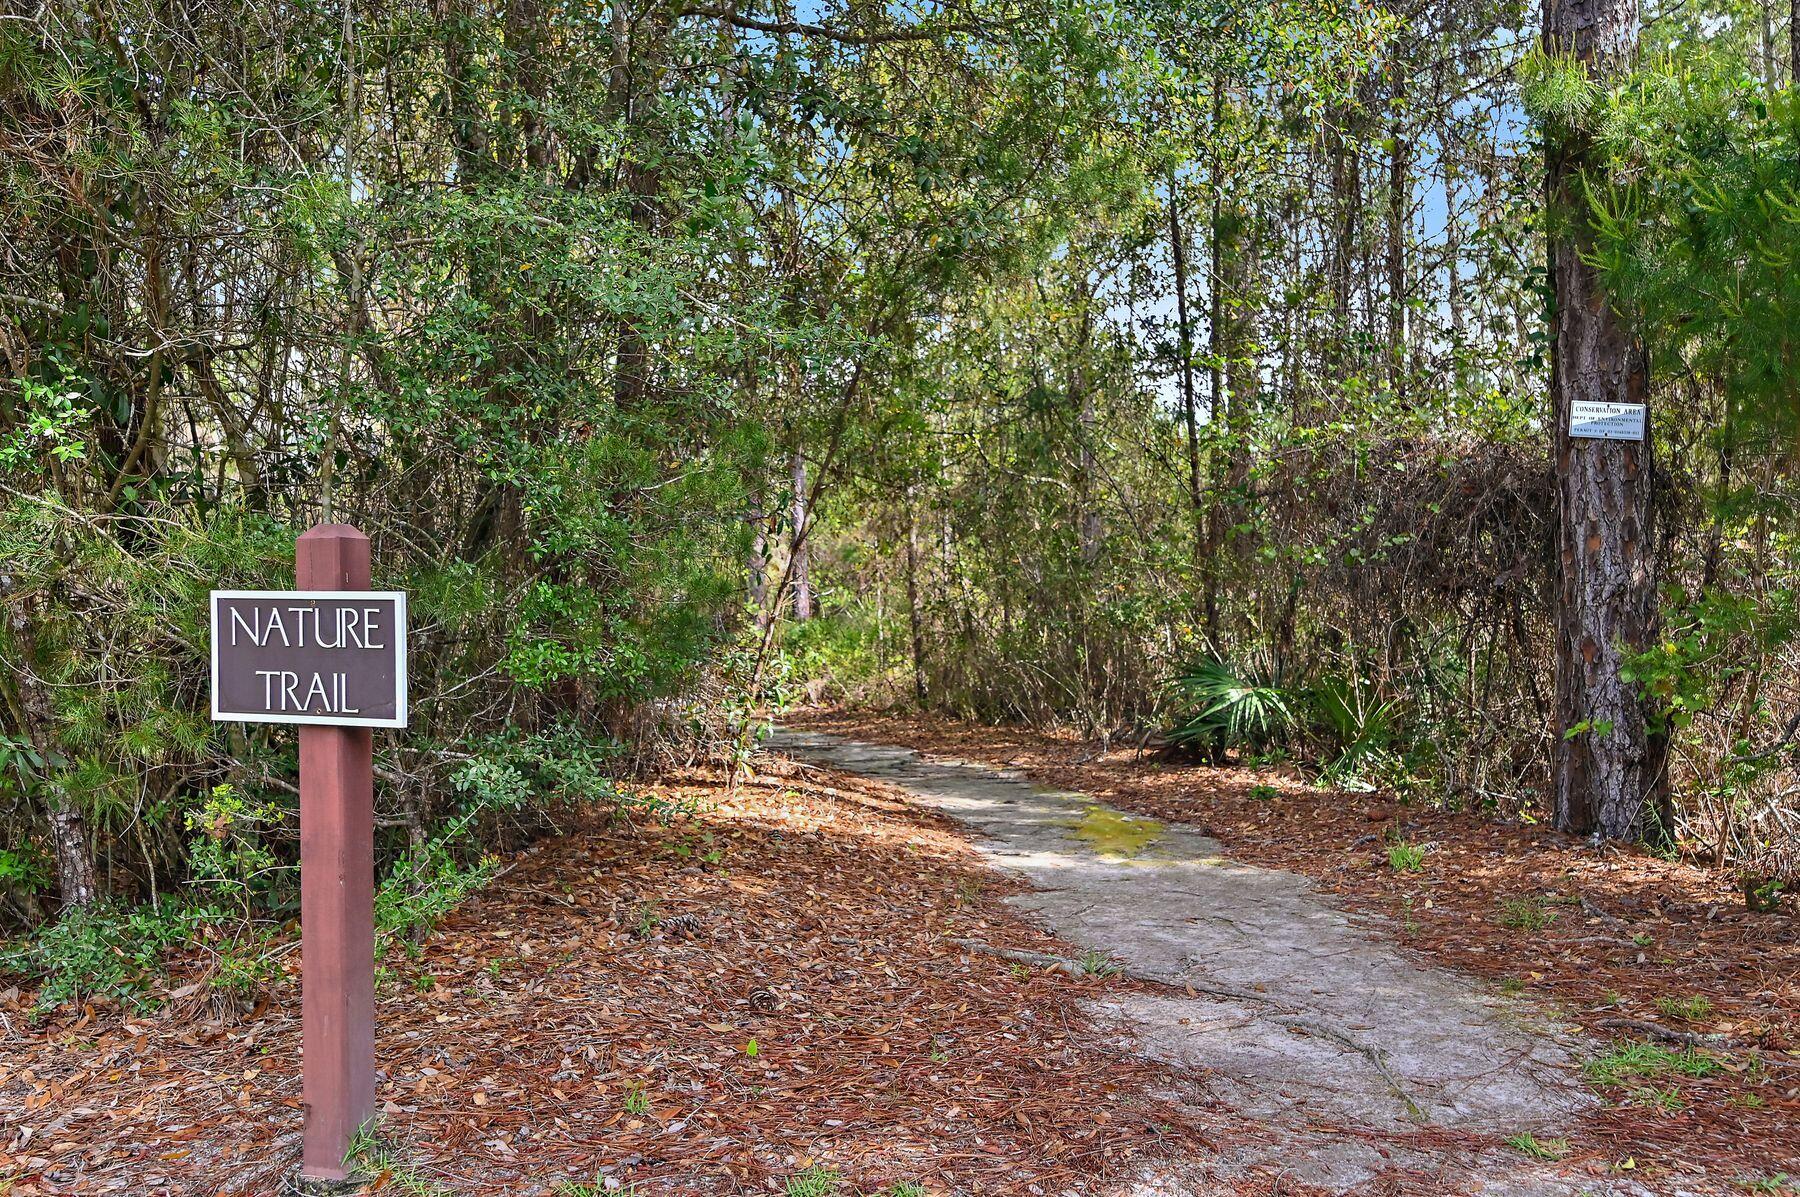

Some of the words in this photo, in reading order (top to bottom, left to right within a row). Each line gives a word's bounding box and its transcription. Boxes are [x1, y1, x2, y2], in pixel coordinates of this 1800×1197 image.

[1576, 406, 1620, 414] CONSERVATION
[230, 606, 384, 649] NATURE
[255, 670, 360, 714] TRAIL
